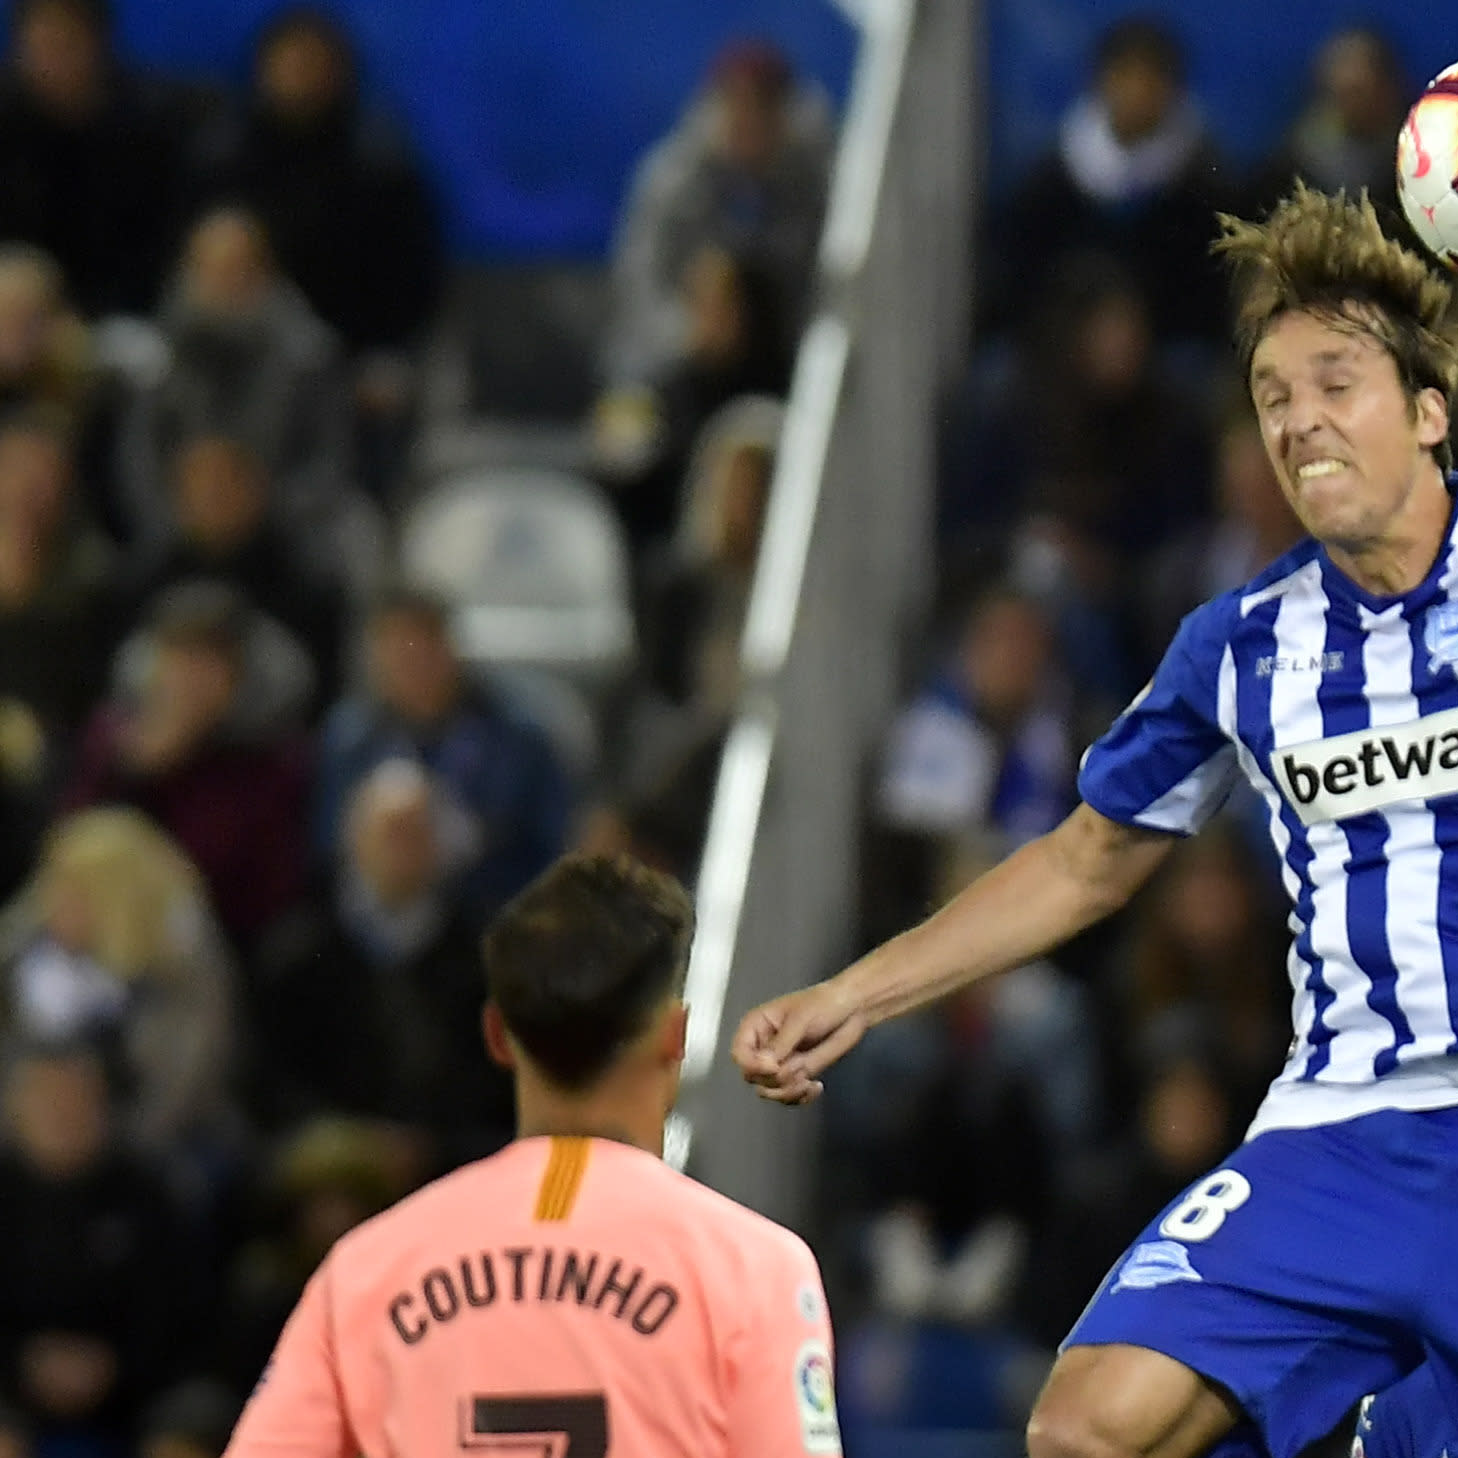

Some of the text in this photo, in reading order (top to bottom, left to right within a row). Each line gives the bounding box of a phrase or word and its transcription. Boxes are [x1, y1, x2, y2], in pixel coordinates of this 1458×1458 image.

[1256, 651, 1345, 676] KELME
[1159, 1168, 1252, 1240] 8
[389, 1246, 679, 1345] COUTINHO
